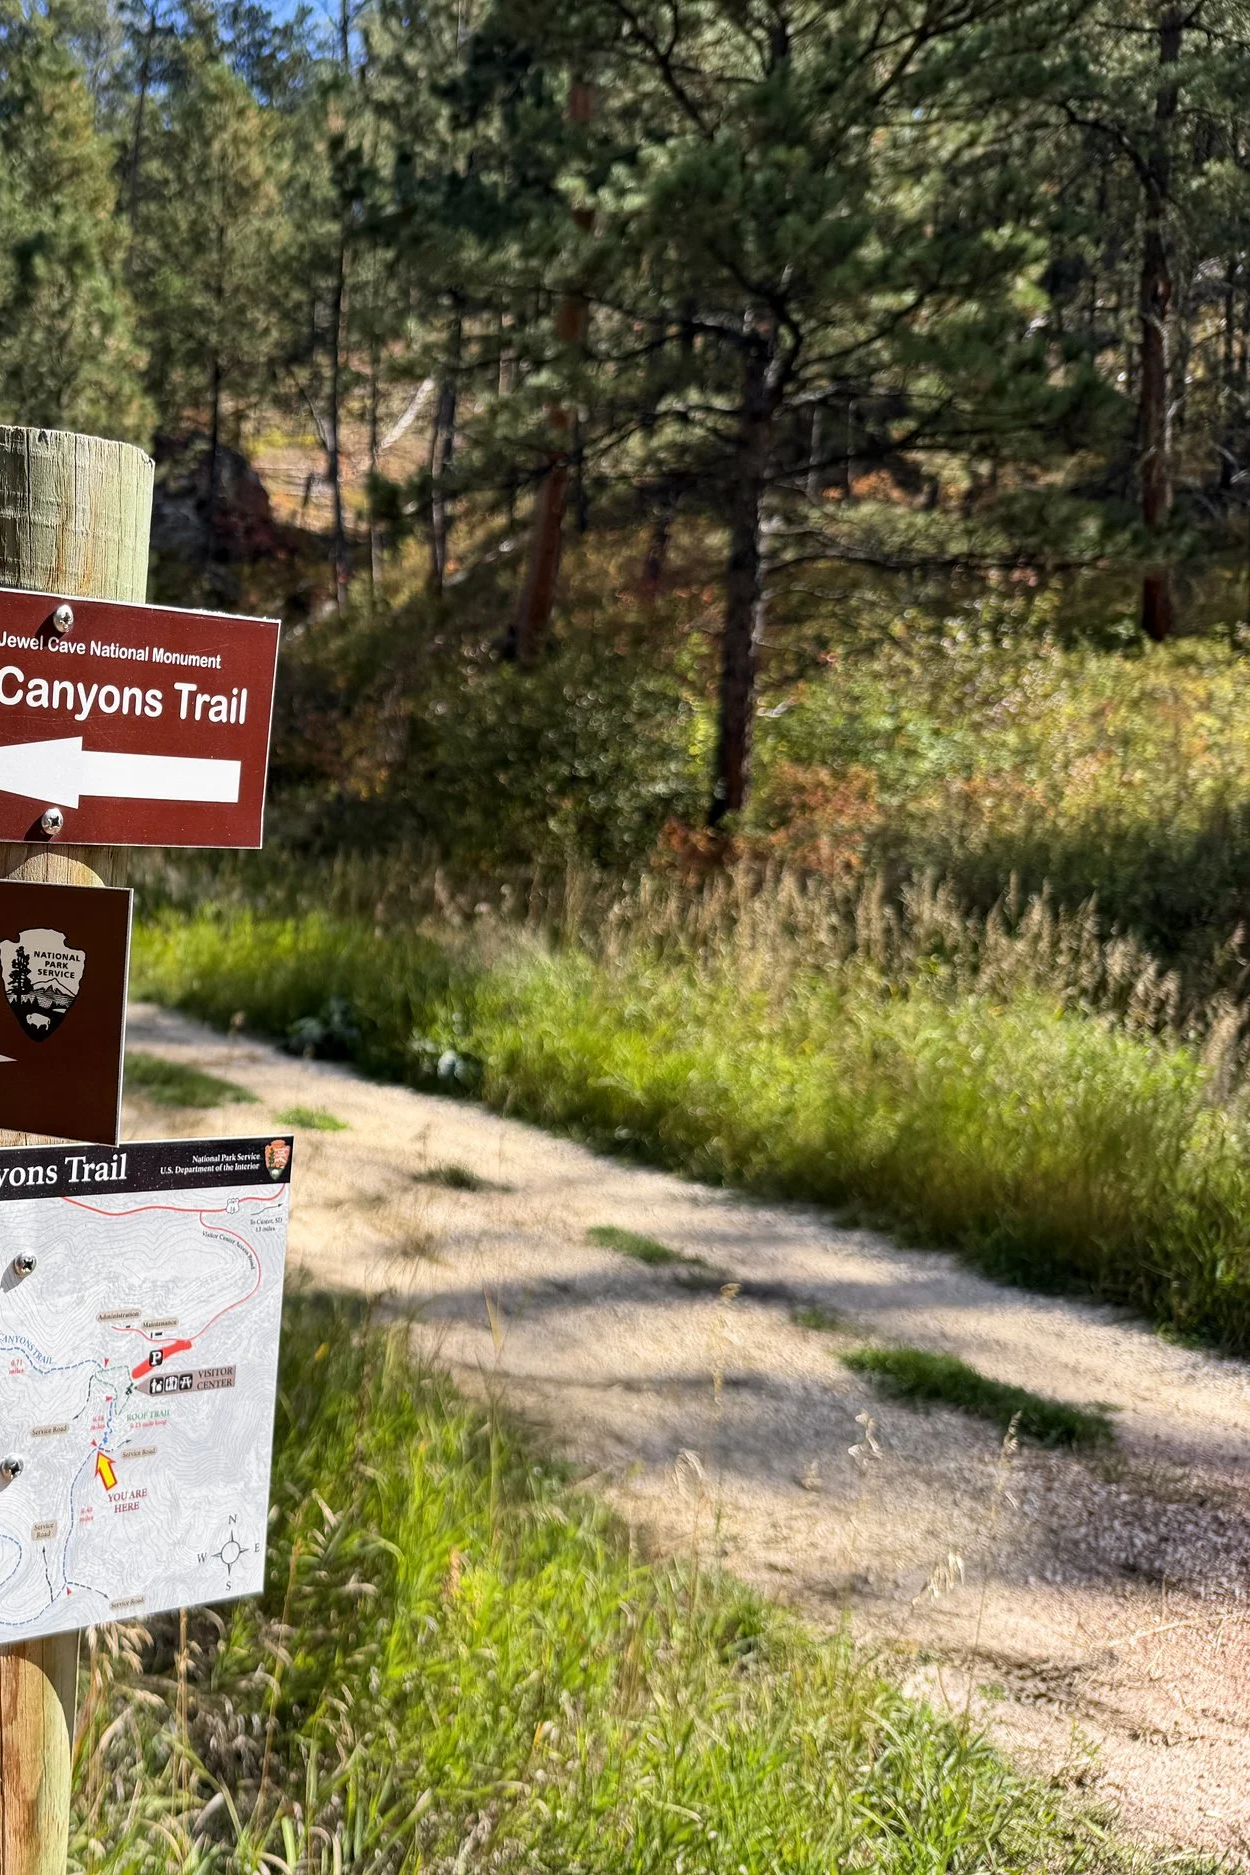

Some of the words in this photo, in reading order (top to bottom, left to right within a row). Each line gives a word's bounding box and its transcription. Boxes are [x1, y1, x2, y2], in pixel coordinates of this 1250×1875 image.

[48, 636, 85, 654] Cave
[90, 641, 149, 662] National
[152, 646, 221, 669] Monument
[174, 683, 247, 724] Trail
[34, 951, 80, 962] NATIONAL
[45, 961, 68, 969] PARK
[38, 969, 75, 978] SERVICE
[192, 1155, 220, 1163] National
[222, 1154, 236, 1162] Park
[65, 1153, 127, 1183] Trail
[175, 1164, 214, 1175] Department
[215, 1163, 222, 1171] of
[235, 1162, 259, 1170] Interior
[98, 1312, 139, 1320] Administration
[33, 1348, 53, 1364] TRAIL
[152, 1352, 161, 1365] P
[198, 1368, 233, 1378] VISITOR
[197, 1378, 232, 1390] CENTER
[150, 1410, 170, 1418] TRAIL
[32, 1428, 51, 1436] Service
[52, 1425, 67, 1433] Road
[107, 1491, 128, 1502] YOU
[130, 1488, 148, 1499] ARE
[114, 1502, 139, 1513] HERE
[228, 1514, 237, 1524] N
[34, 1523, 53, 1531] Service
[255, 1543, 260, 1552] E
[197, 1553, 206, 1563] W
[226, 1581, 231, 1590] S
